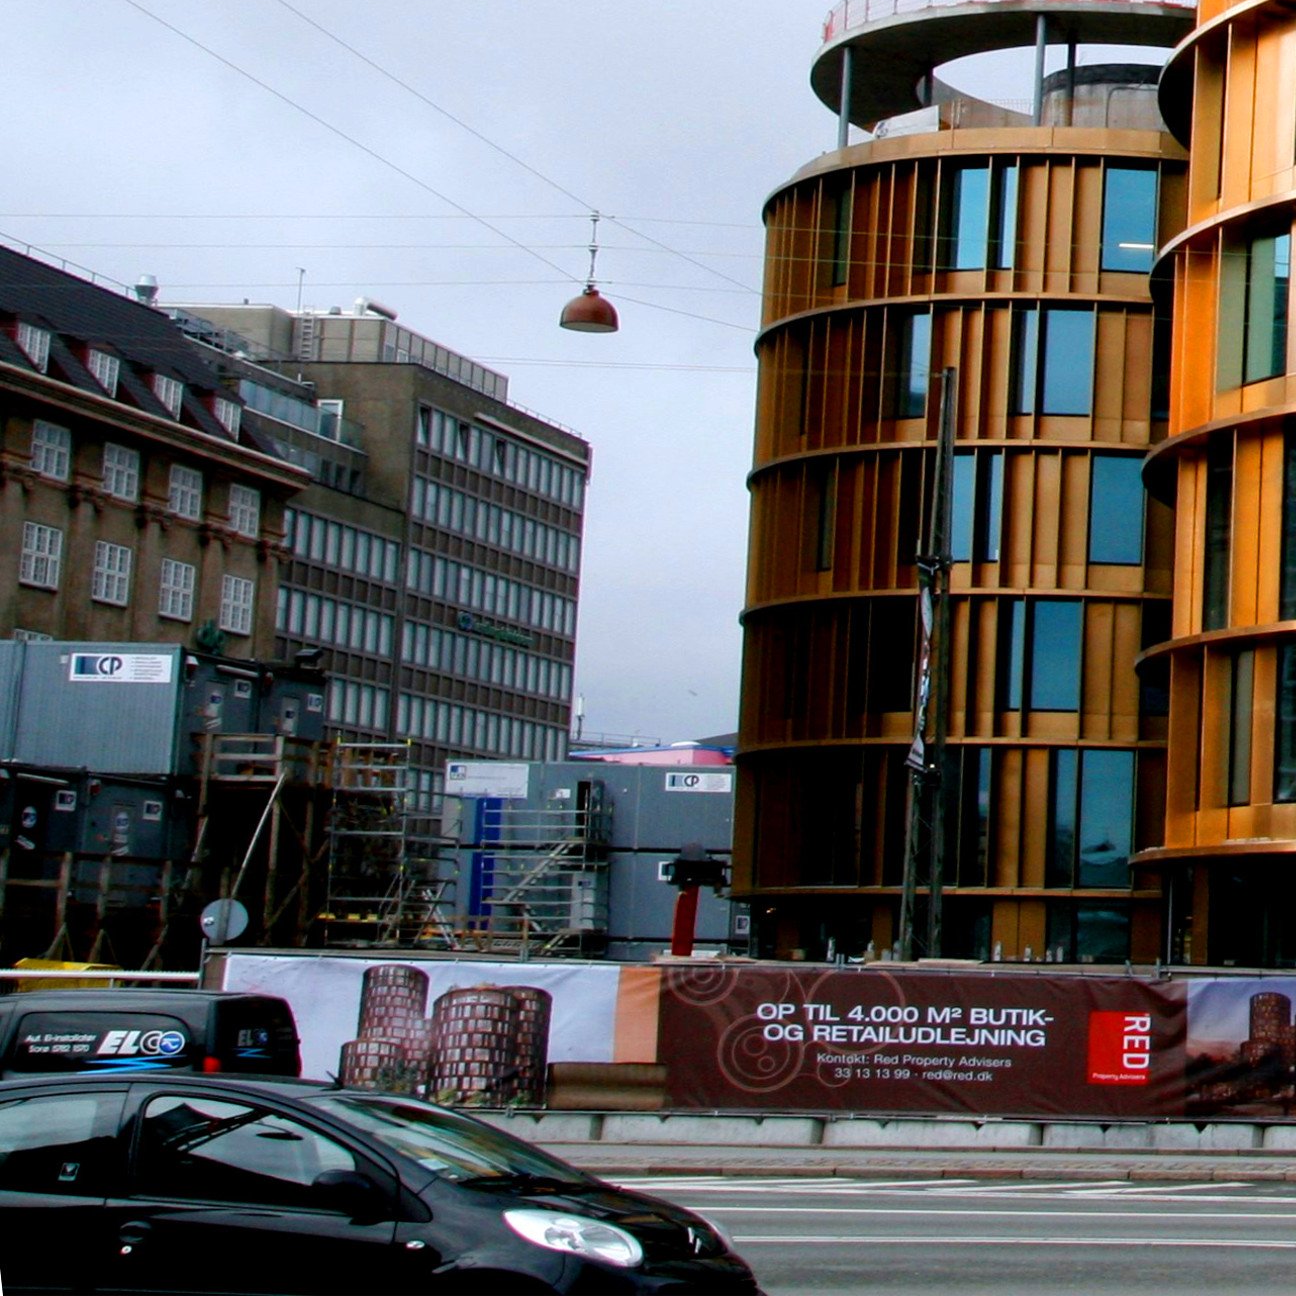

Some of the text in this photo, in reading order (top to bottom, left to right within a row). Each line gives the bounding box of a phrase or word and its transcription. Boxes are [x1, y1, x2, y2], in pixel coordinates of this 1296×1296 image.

[757, 1003, 1054, 1026] OP TIL 4.000 M² BUTIK-
[763, 1024, 1046, 1047] OG RETAILUDLEJNING
[1123, 1016, 1151, 1069] RED
[817, 1053, 1012, 1068] Kontakt: Red Property Advisers
[834, 1067, 993, 1082] 33 13 13 99 red@red.dk
